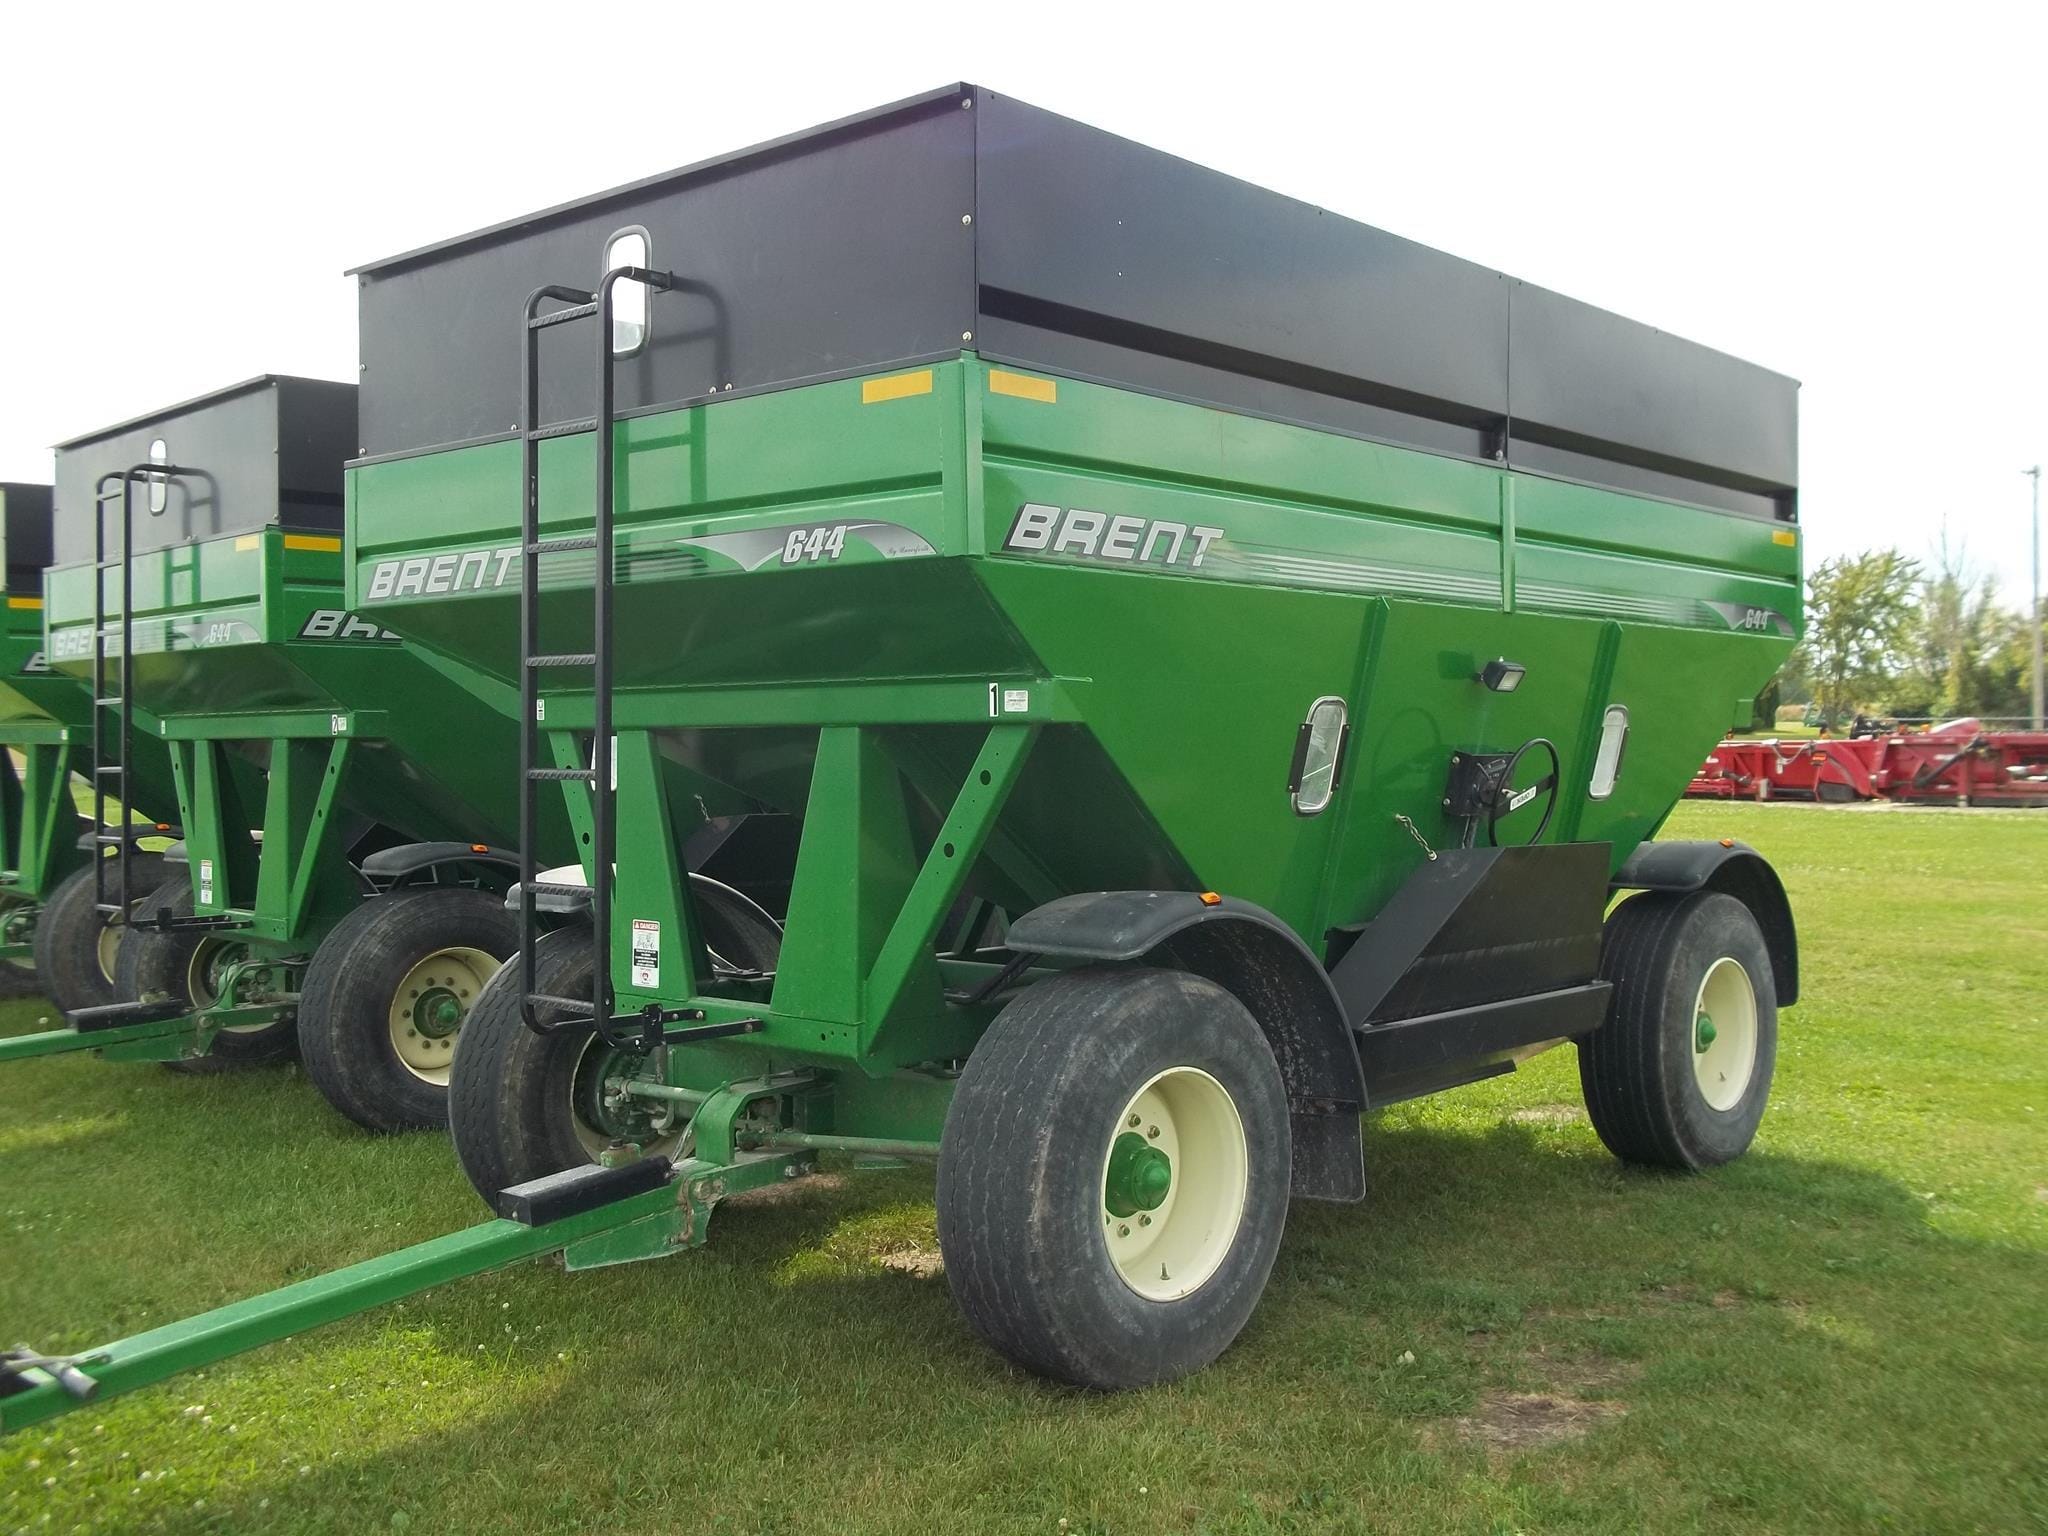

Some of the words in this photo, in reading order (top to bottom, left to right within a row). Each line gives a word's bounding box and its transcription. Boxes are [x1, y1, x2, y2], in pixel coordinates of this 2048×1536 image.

[782, 524, 847, 563] 644
[1009, 503, 1223, 567] BRENT
[368, 546, 524, 600] BRENT
[209, 622, 231, 643] 644
[1745, 608, 1769, 630] 644
